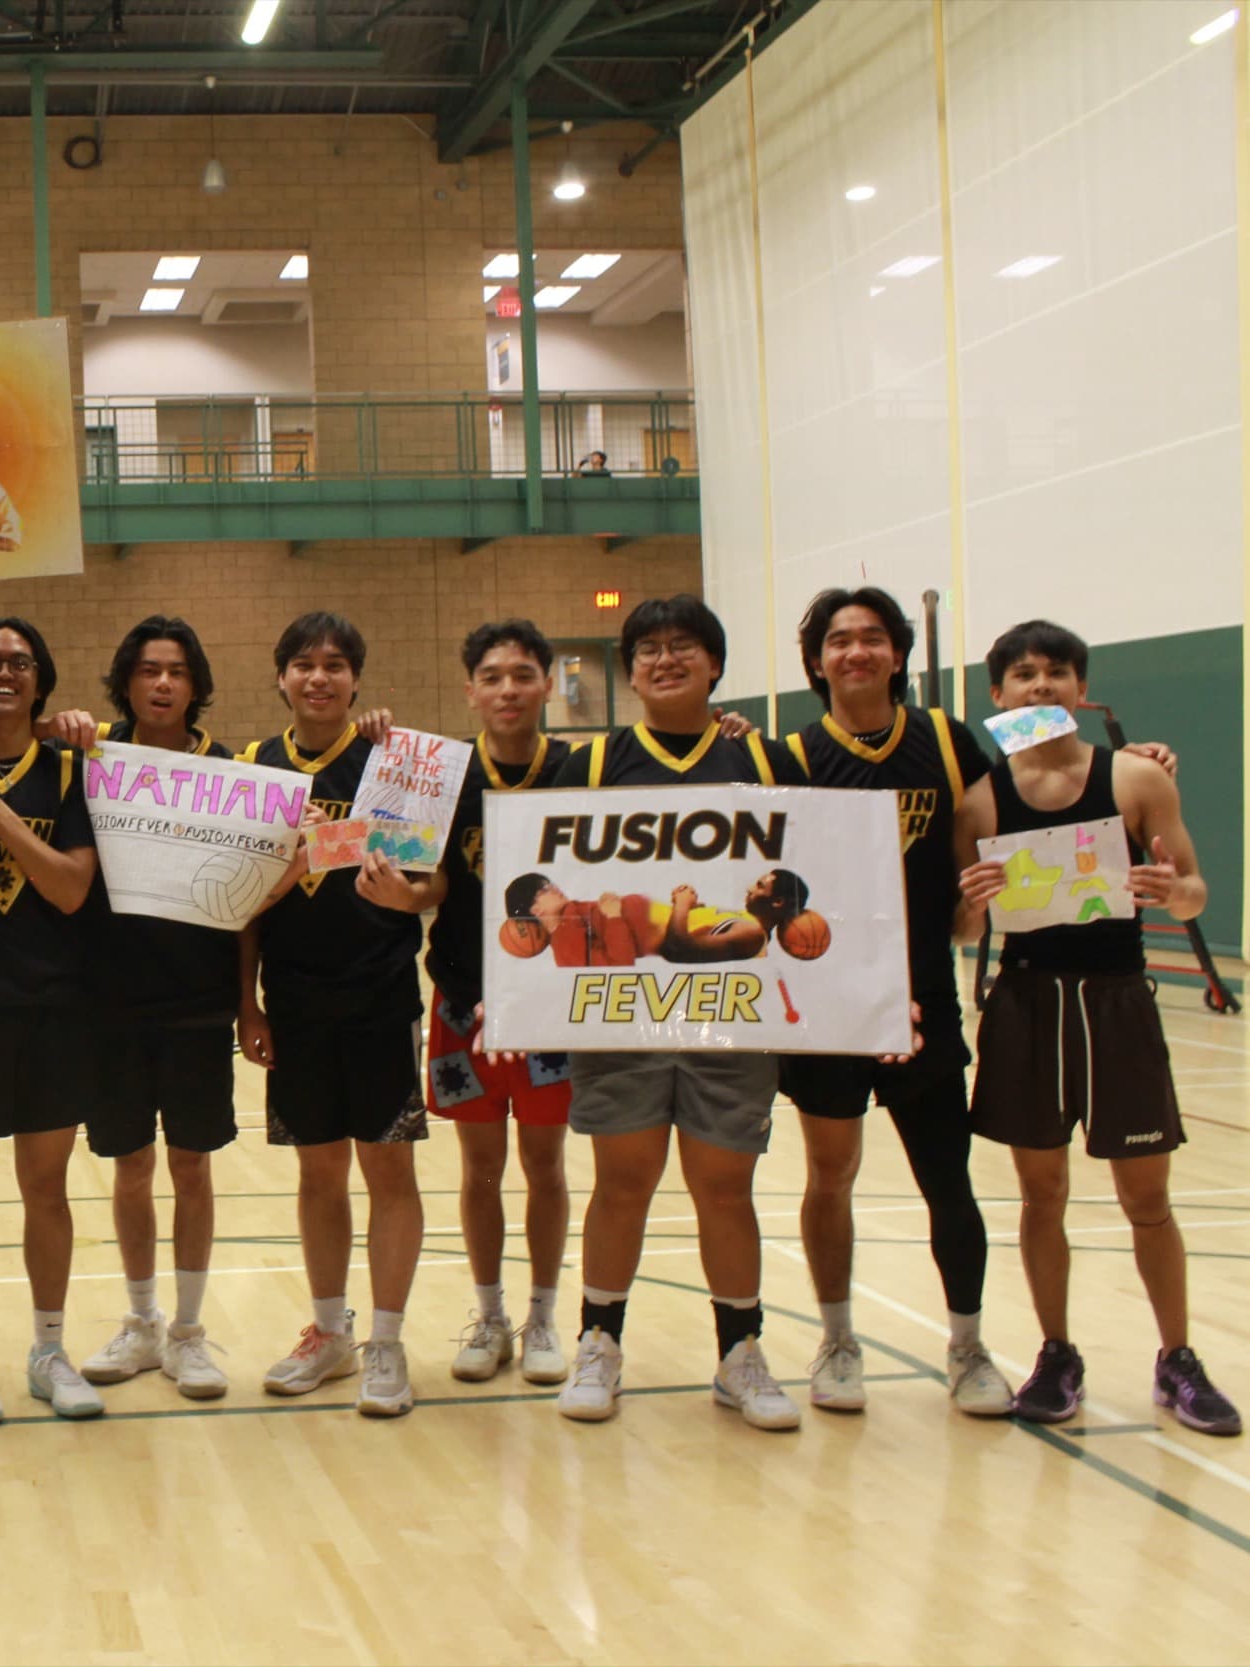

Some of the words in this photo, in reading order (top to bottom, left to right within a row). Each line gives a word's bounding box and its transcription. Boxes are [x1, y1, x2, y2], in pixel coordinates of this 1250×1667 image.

[383, 730, 444, 760] TALK
[385, 753, 403, 767] TO
[412, 760, 446, 777] THE
[86, 758, 307, 829] NATHAN
[377, 766, 444, 798] HANDS
[537, 810, 787, 863] FUSION
[568, 972, 762, 1023] FEVER
